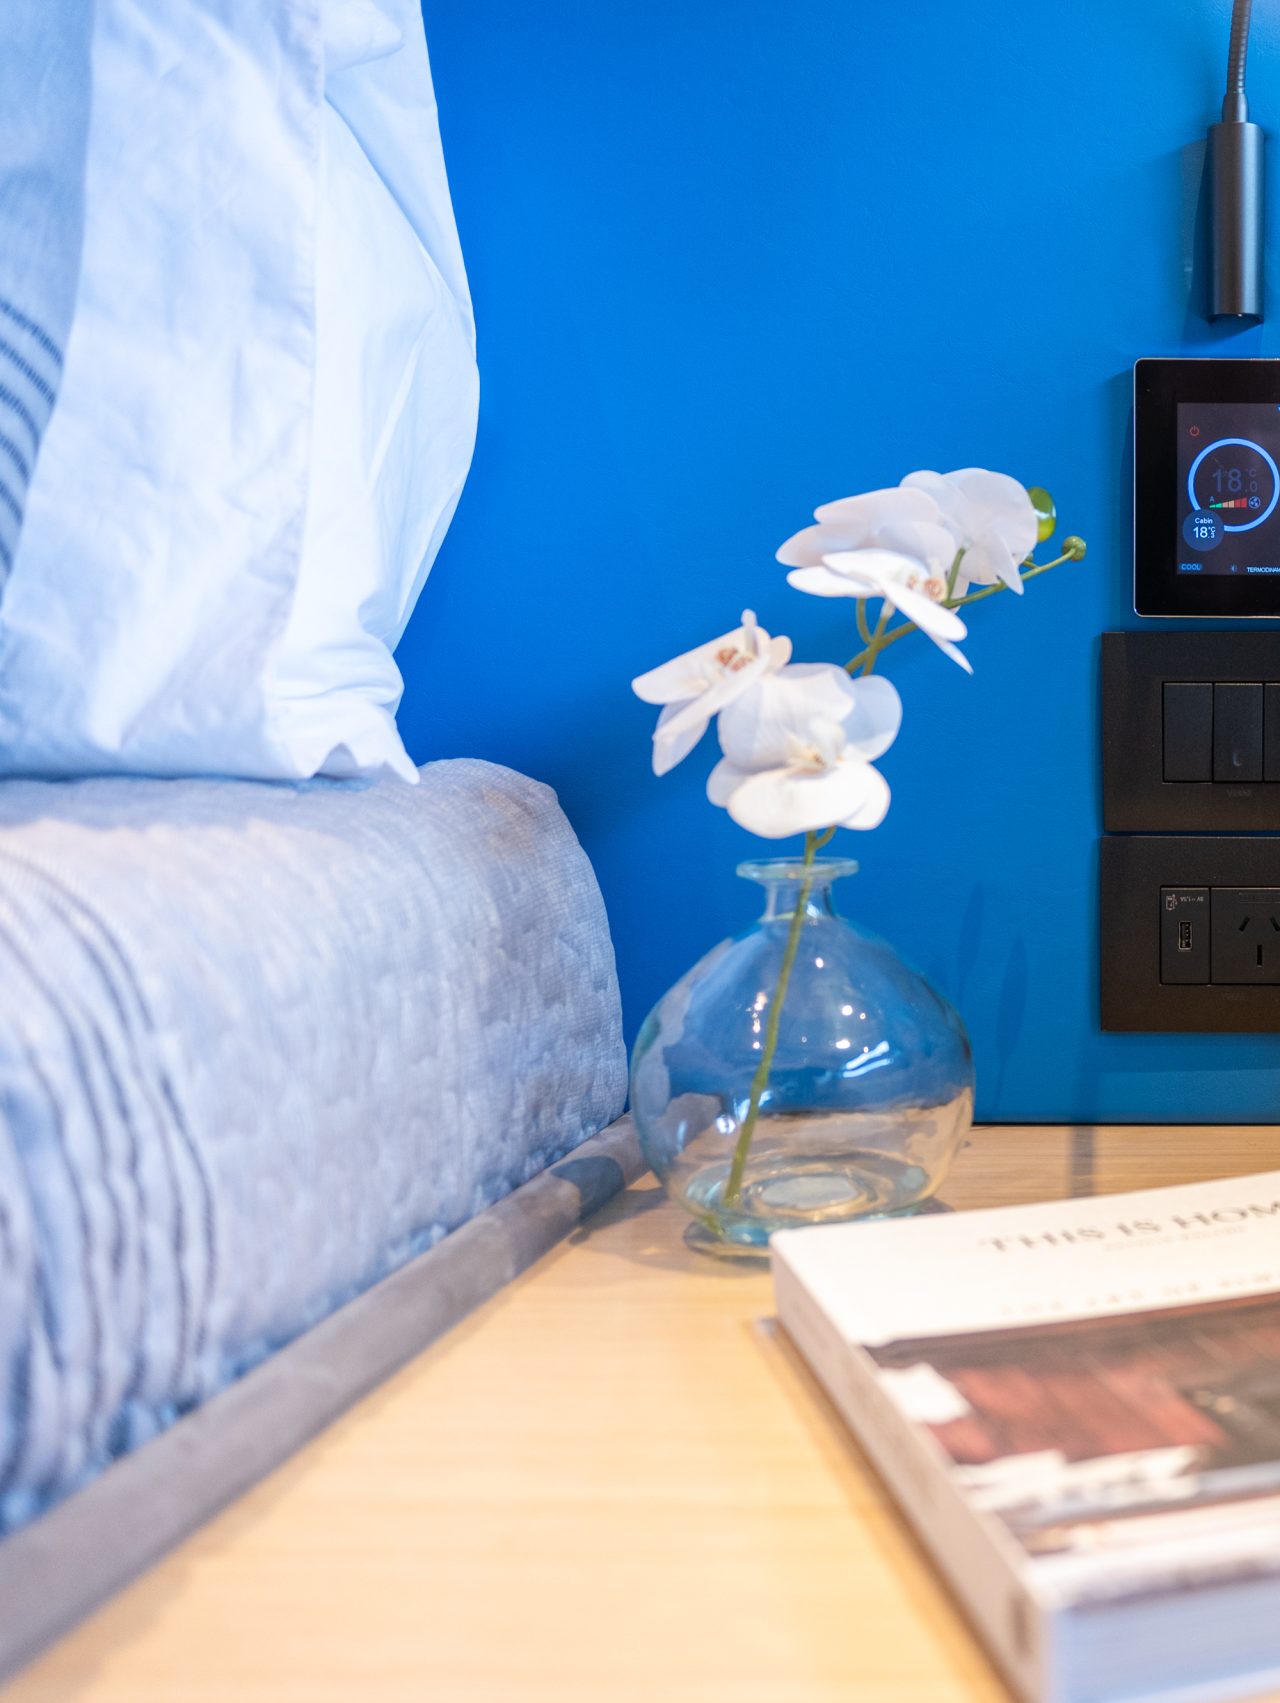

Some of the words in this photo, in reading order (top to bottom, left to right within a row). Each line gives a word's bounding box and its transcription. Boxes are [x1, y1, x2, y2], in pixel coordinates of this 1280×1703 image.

[1180, 563, 1201, 571] COOL
[978, 1227, 1106, 1252] THIS
[1115, 1218, 1163, 1237] IS
